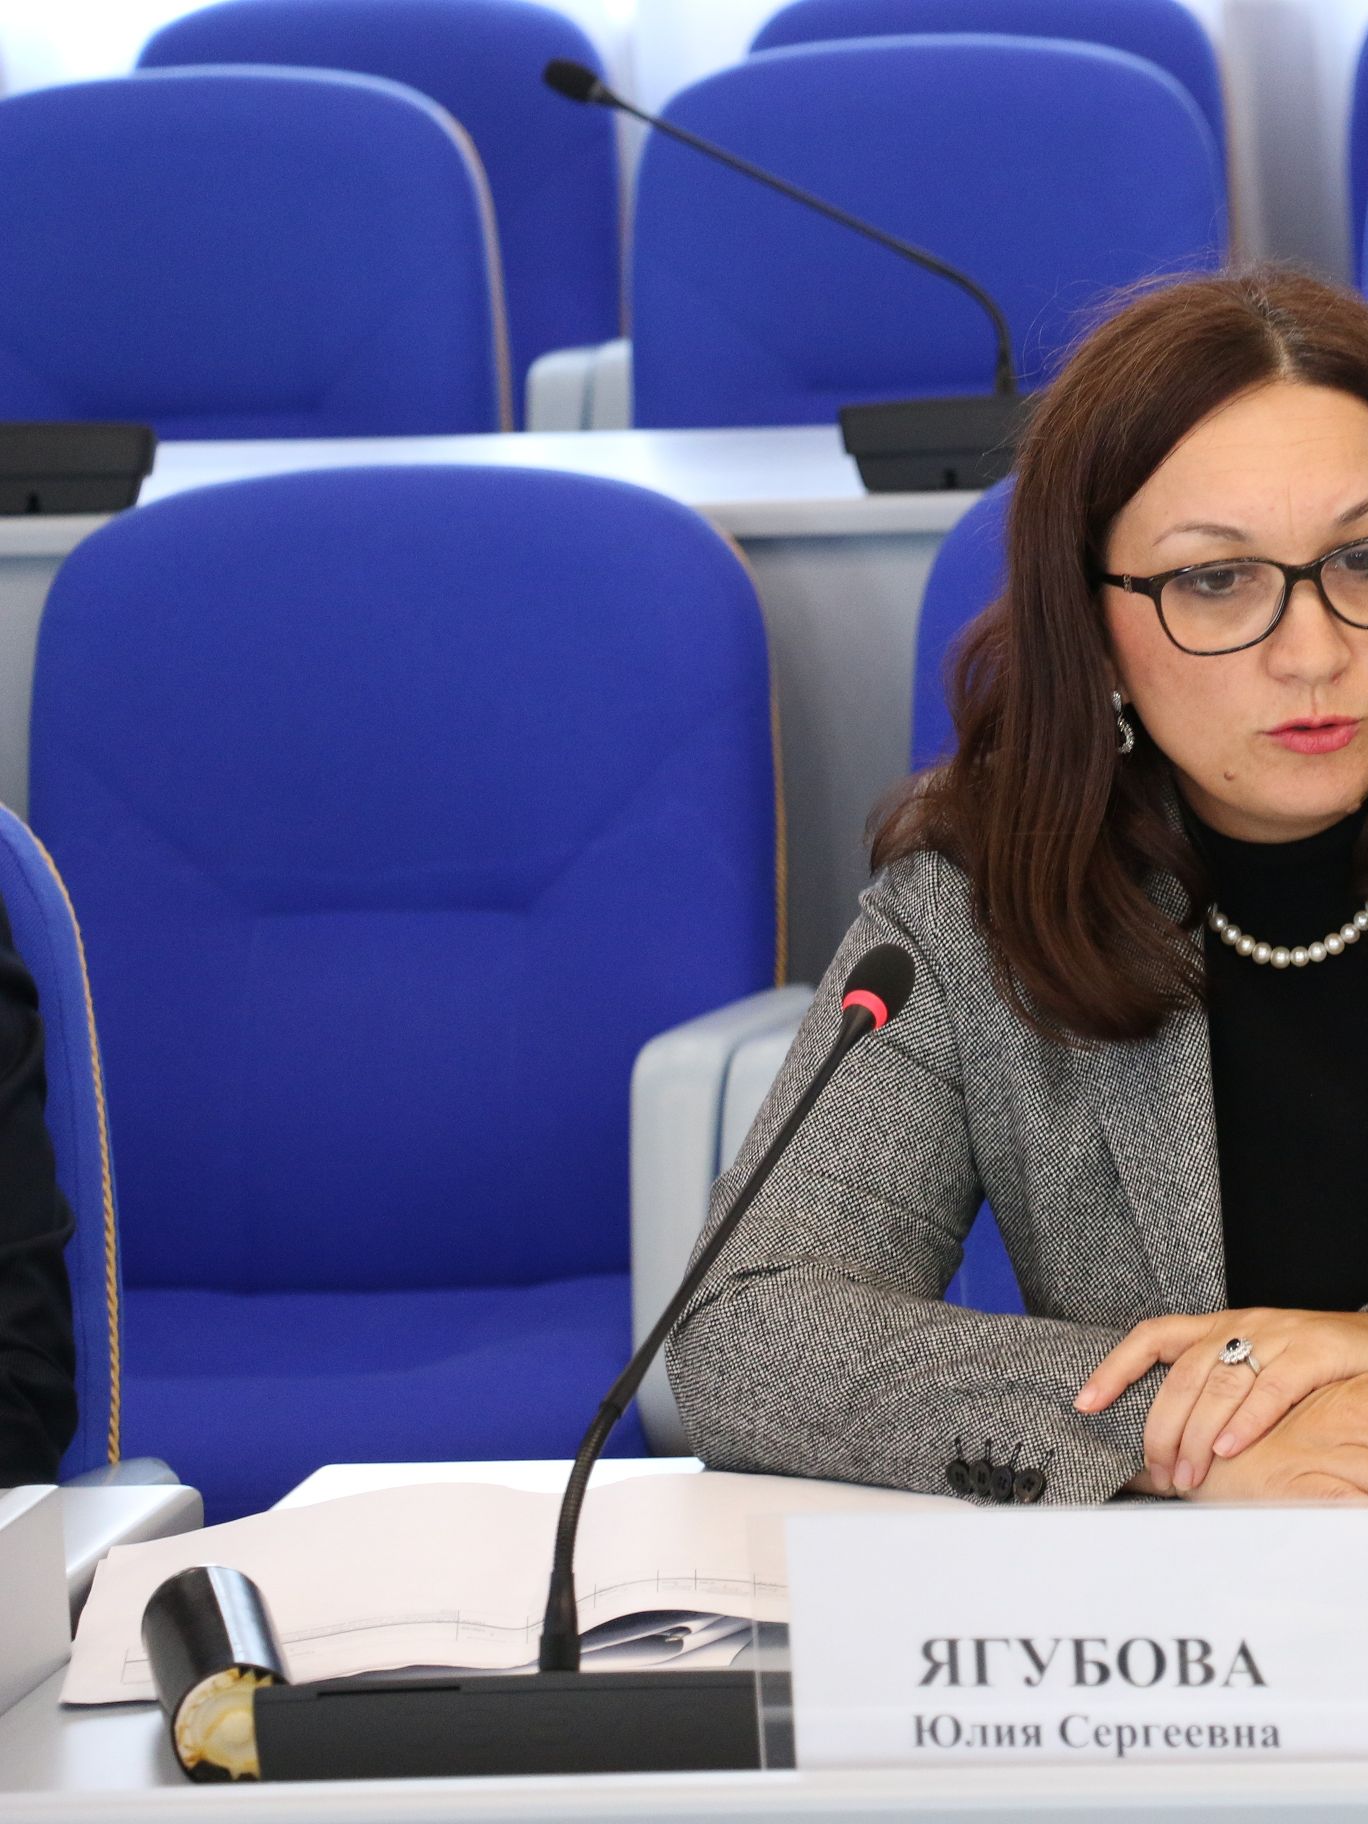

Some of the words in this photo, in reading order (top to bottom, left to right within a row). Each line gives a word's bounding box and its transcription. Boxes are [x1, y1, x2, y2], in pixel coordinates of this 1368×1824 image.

[917, 1637, 1270, 1688] ЯГУБОВА
[913, 1713, 1044, 1749] Юлия
[1057, 1713, 1282, 1758] Сергеевна
